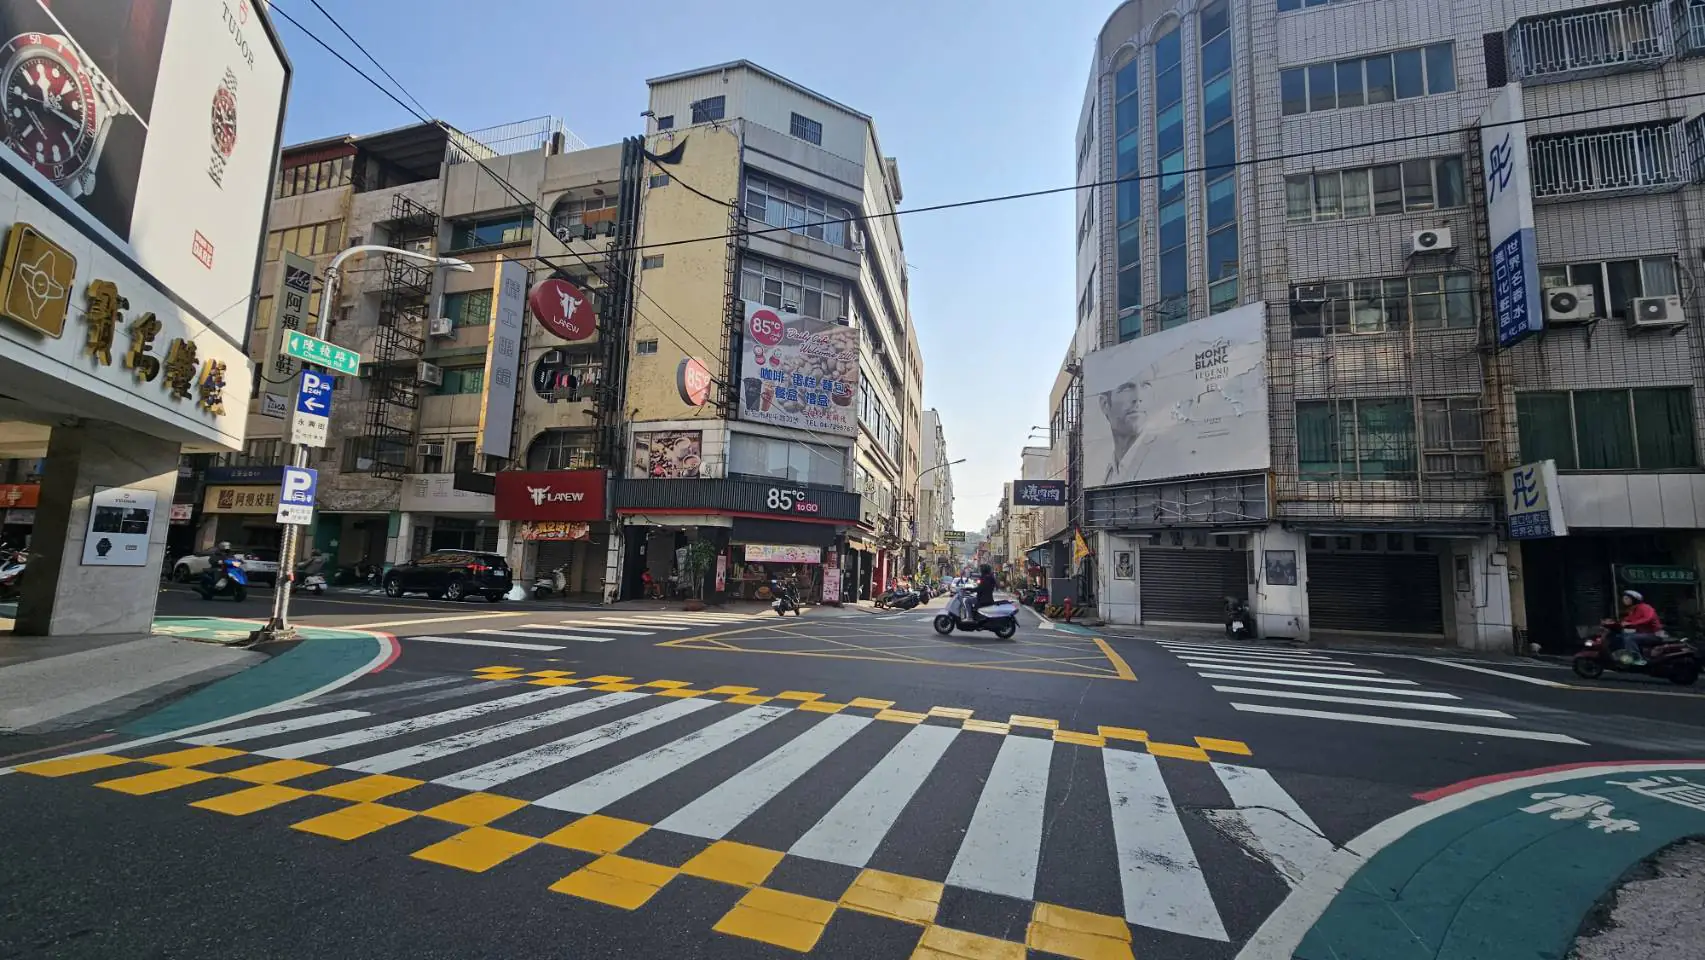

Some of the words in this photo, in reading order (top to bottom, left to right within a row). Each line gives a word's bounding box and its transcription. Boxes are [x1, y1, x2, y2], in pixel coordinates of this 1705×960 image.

[30, 34, 42, 45] 50
[221, 2, 254, 71] TUDOR
[1488, 132, 1513, 204] 彤
[1506, 238, 1526, 320] 世界名香水
[275, 291, 304, 376] 阿瘦鞋
[786, 327, 811, 343] Daily
[799, 343, 837, 358] Welcome
[1195, 345, 1227, 362] MONT
[1195, 354, 1229, 370] BLANC
[302, 373, 320, 393] P
[760, 367, 784, 383] 咖啡
[792, 373, 816, 389] 蛋糕
[307, 387, 322, 395] 24H
[282, 469, 312, 501] P
[1512, 467, 1540, 511] 彤
[766, 488, 805, 511] 85°C
[796, 503, 806, 511] to
[806, 503, 818, 512] GO
